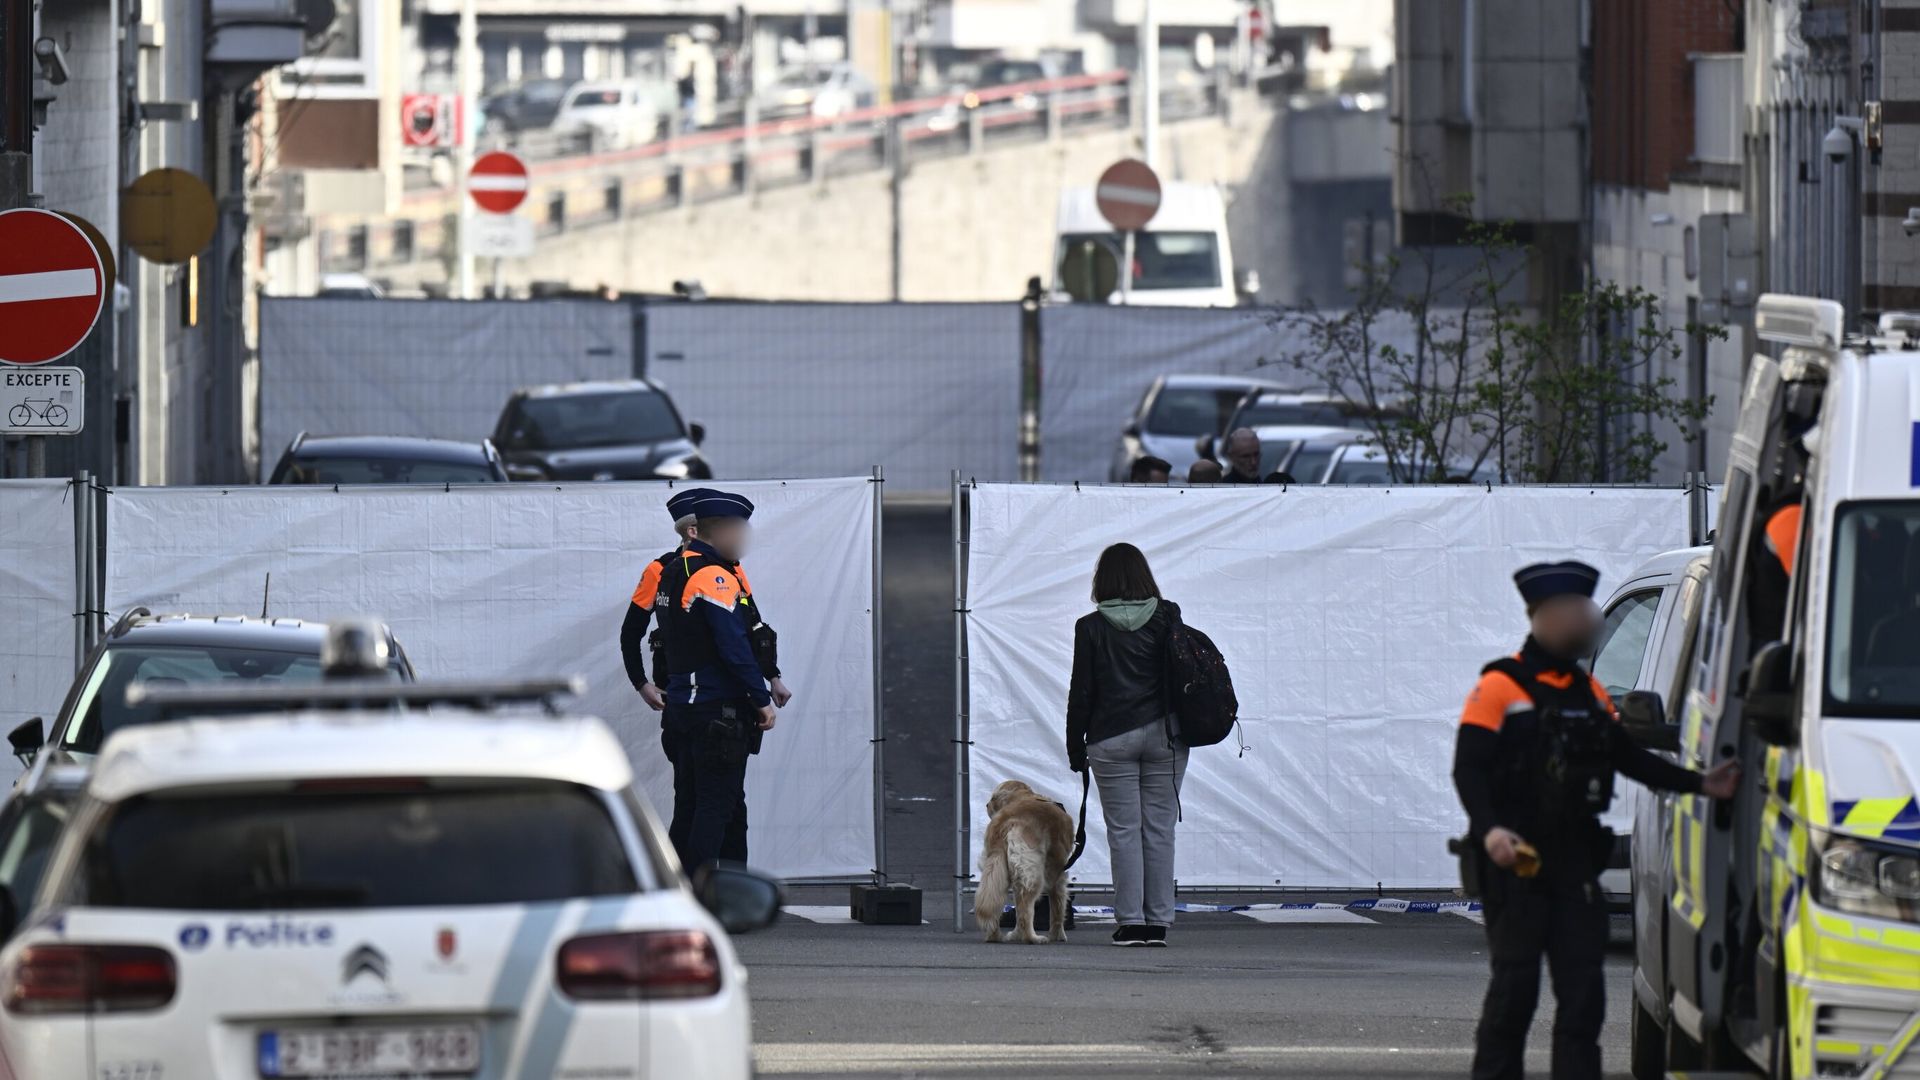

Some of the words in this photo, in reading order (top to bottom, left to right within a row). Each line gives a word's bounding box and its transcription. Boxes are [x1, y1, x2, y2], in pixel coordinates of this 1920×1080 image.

[7, 374, 70, 386] EXCEPTE
[656, 591, 670, 607] Police
[225, 916, 336, 950] Police
